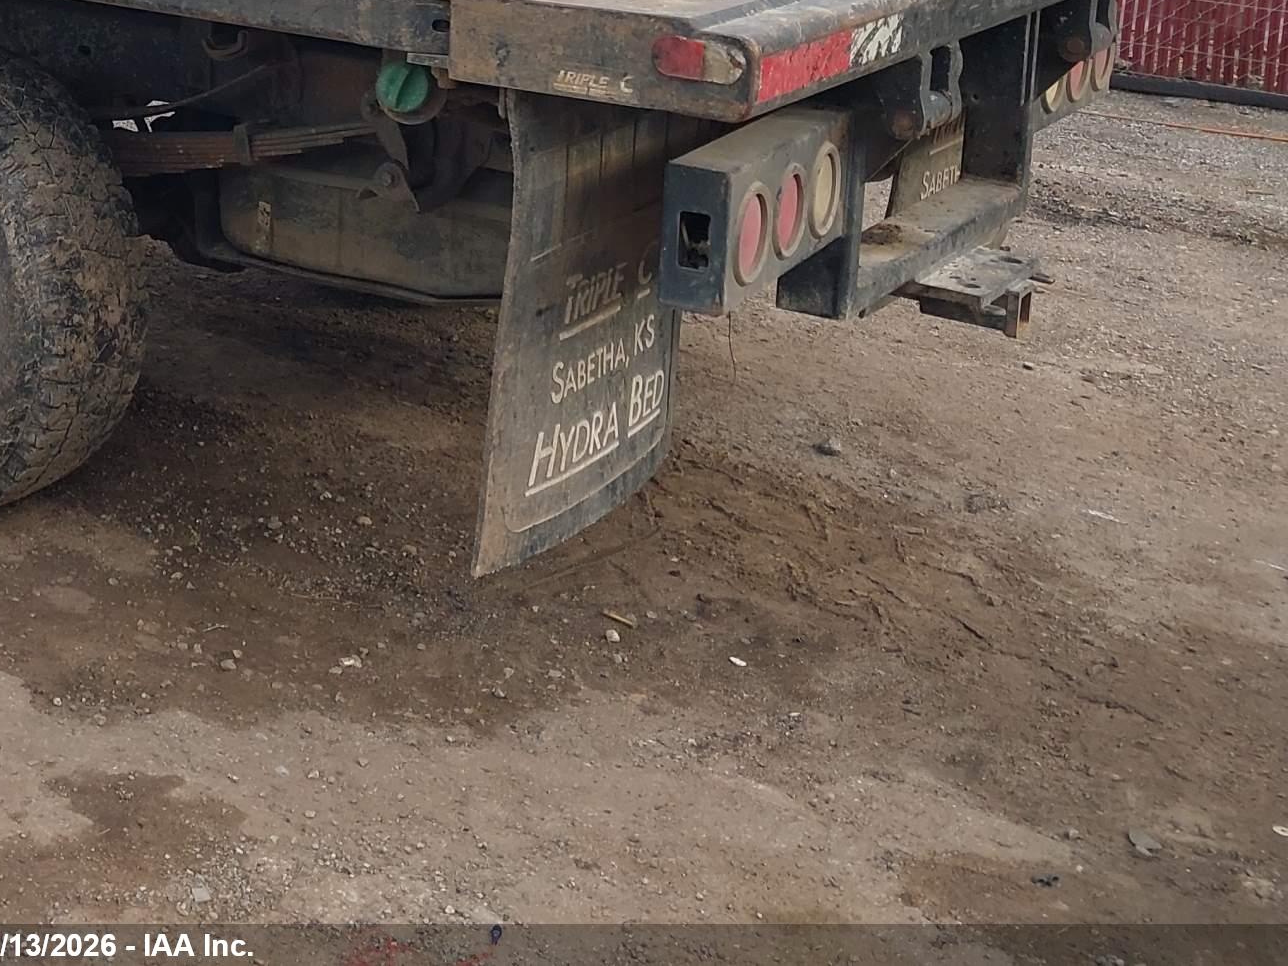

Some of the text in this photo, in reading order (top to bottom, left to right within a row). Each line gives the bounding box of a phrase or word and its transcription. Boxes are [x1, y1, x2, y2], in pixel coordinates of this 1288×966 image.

[550, 314, 655, 404] SABETHA, KS
[527, 370, 665, 487] HYDRA BED
